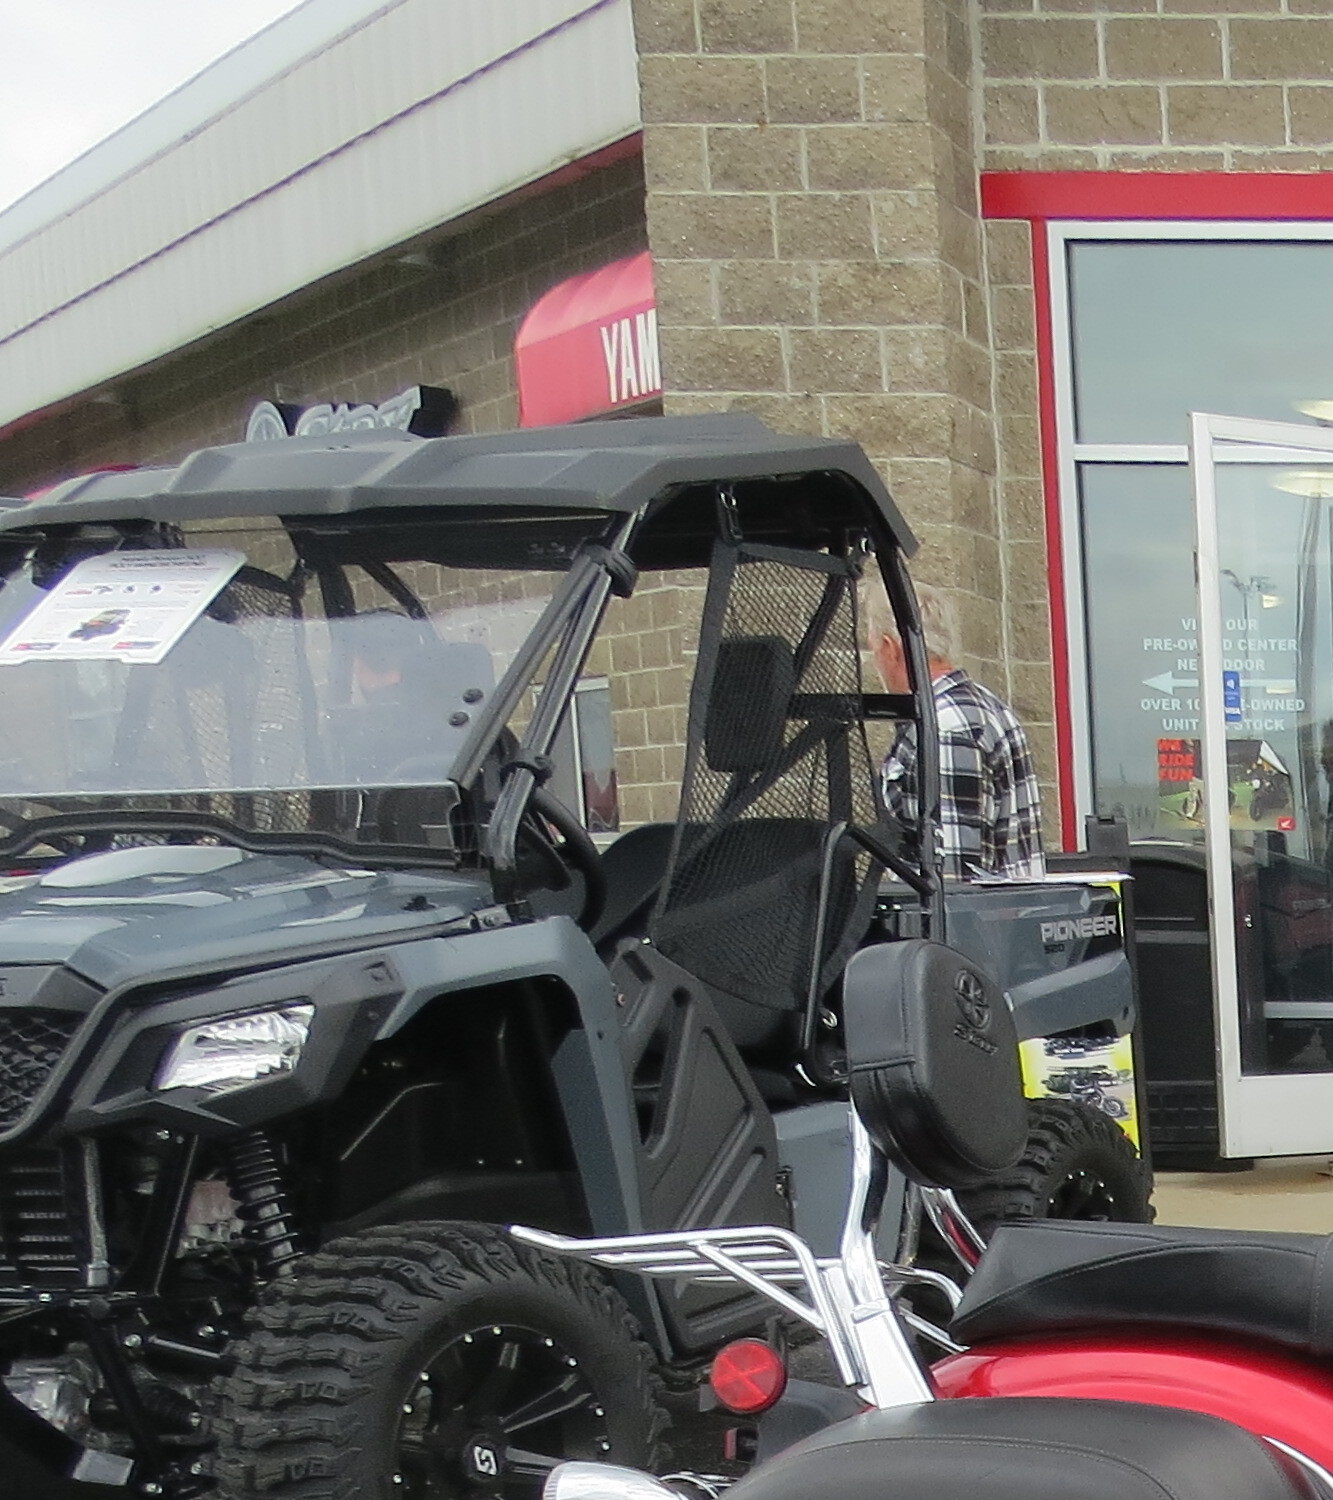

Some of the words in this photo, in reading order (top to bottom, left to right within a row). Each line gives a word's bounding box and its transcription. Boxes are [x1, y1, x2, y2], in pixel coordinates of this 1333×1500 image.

[600, 308, 662, 404] YAM
[1226, 619, 1259, 631] OUR
[1144, 639, 1232, 651] PRE-OWD
[1238, 639, 1297, 651] CENTER
[1177, 658, 1198, 671] NE
[1223, 659, 1265, 671] DOOR
[1141, 699, 1181, 711] OVER
[1162, 719, 1198, 731] UNIT
[1040, 915, 1117, 943] PIONEER
